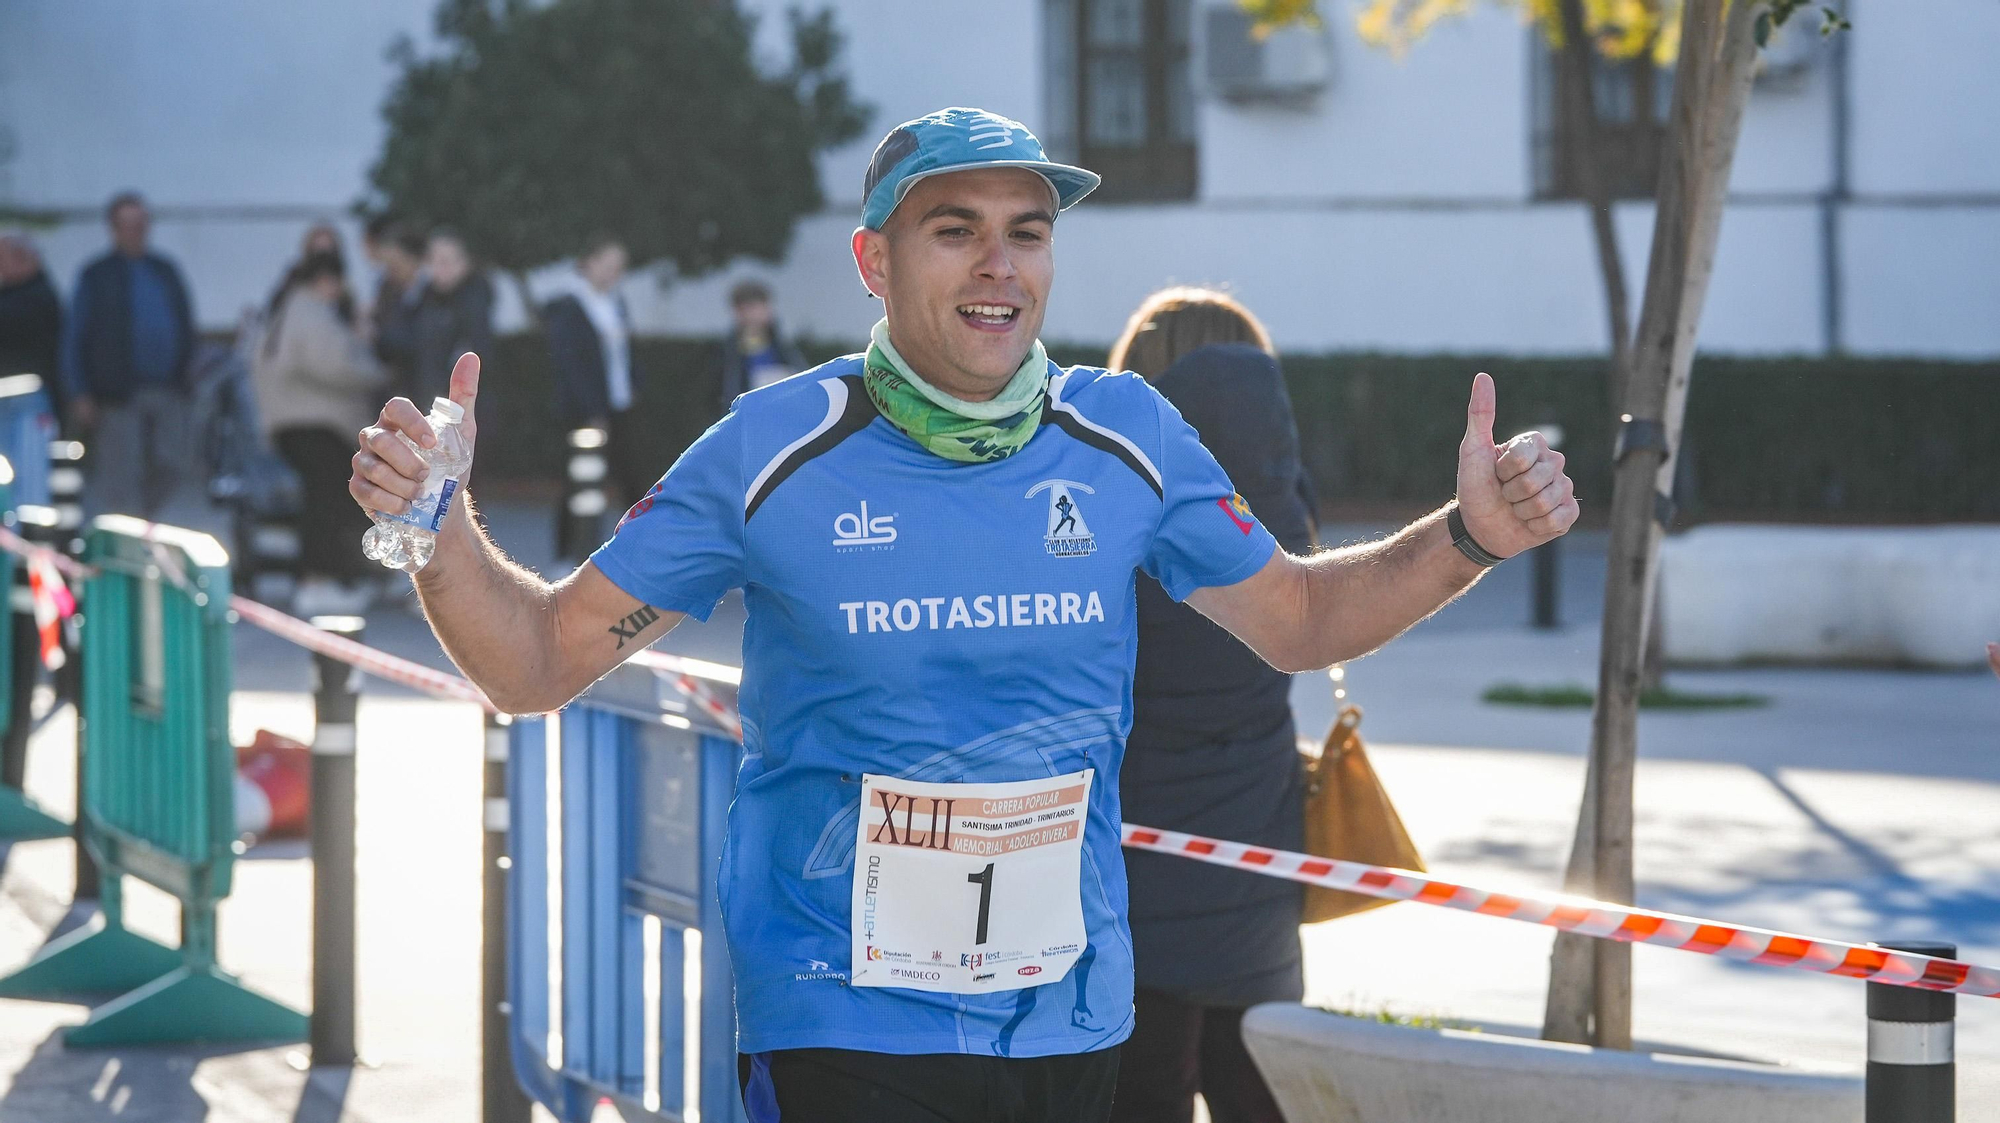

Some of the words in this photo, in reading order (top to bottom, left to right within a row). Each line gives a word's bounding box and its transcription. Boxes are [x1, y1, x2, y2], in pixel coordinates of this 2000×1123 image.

[833, 500, 898, 546] als
[1045, 541, 1097, 552] TROTASIERRA
[839, 590, 1104, 634] TROTASIERRA
[608, 604, 660, 650] XIII
[982, 799, 1023, 815] CARRERA
[1024, 791, 1060, 810] POPULAR
[871, 790, 956, 851] XLII
[1004, 817, 1033, 829] TRINIDAD
[1037, 808, 1075, 822] TRINITARIOS
[953, 836, 1003, 856] MEMORIAL
[967, 862, 995, 946] 1
[985, 951, 1001, 961] fest
[901, 970, 941, 981] IMDECO
